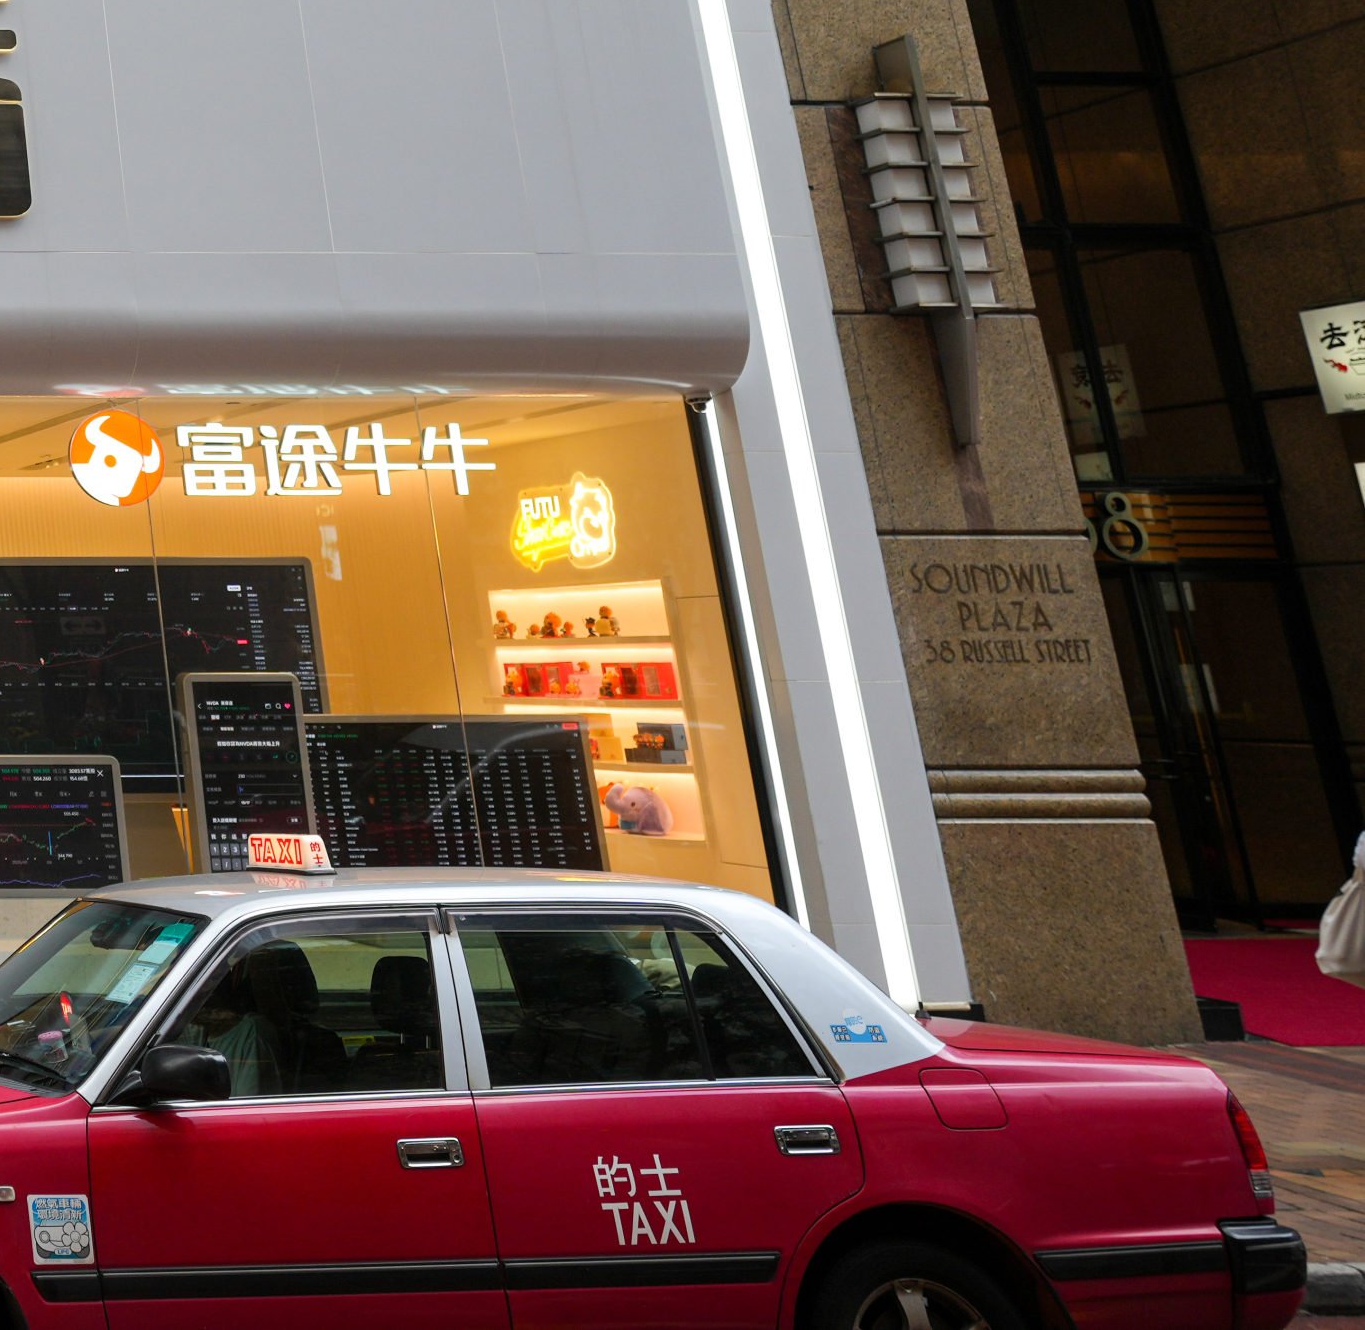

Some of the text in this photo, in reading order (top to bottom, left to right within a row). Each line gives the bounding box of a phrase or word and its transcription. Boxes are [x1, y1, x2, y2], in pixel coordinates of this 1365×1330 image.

[176, 421, 496, 498] 富途牛牛
[911, 563, 1074, 596] SOUNDWILL
[957, 601, 1053, 632] PLAZA
[924, 638, 1093, 664] 38 RUSSELL STREET
[250, 838, 302, 864] TAXI
[309, 842, 324, 864] 的士
[592, 1153, 683, 1198] 的士
[601, 1199, 697, 1246] TAXI
